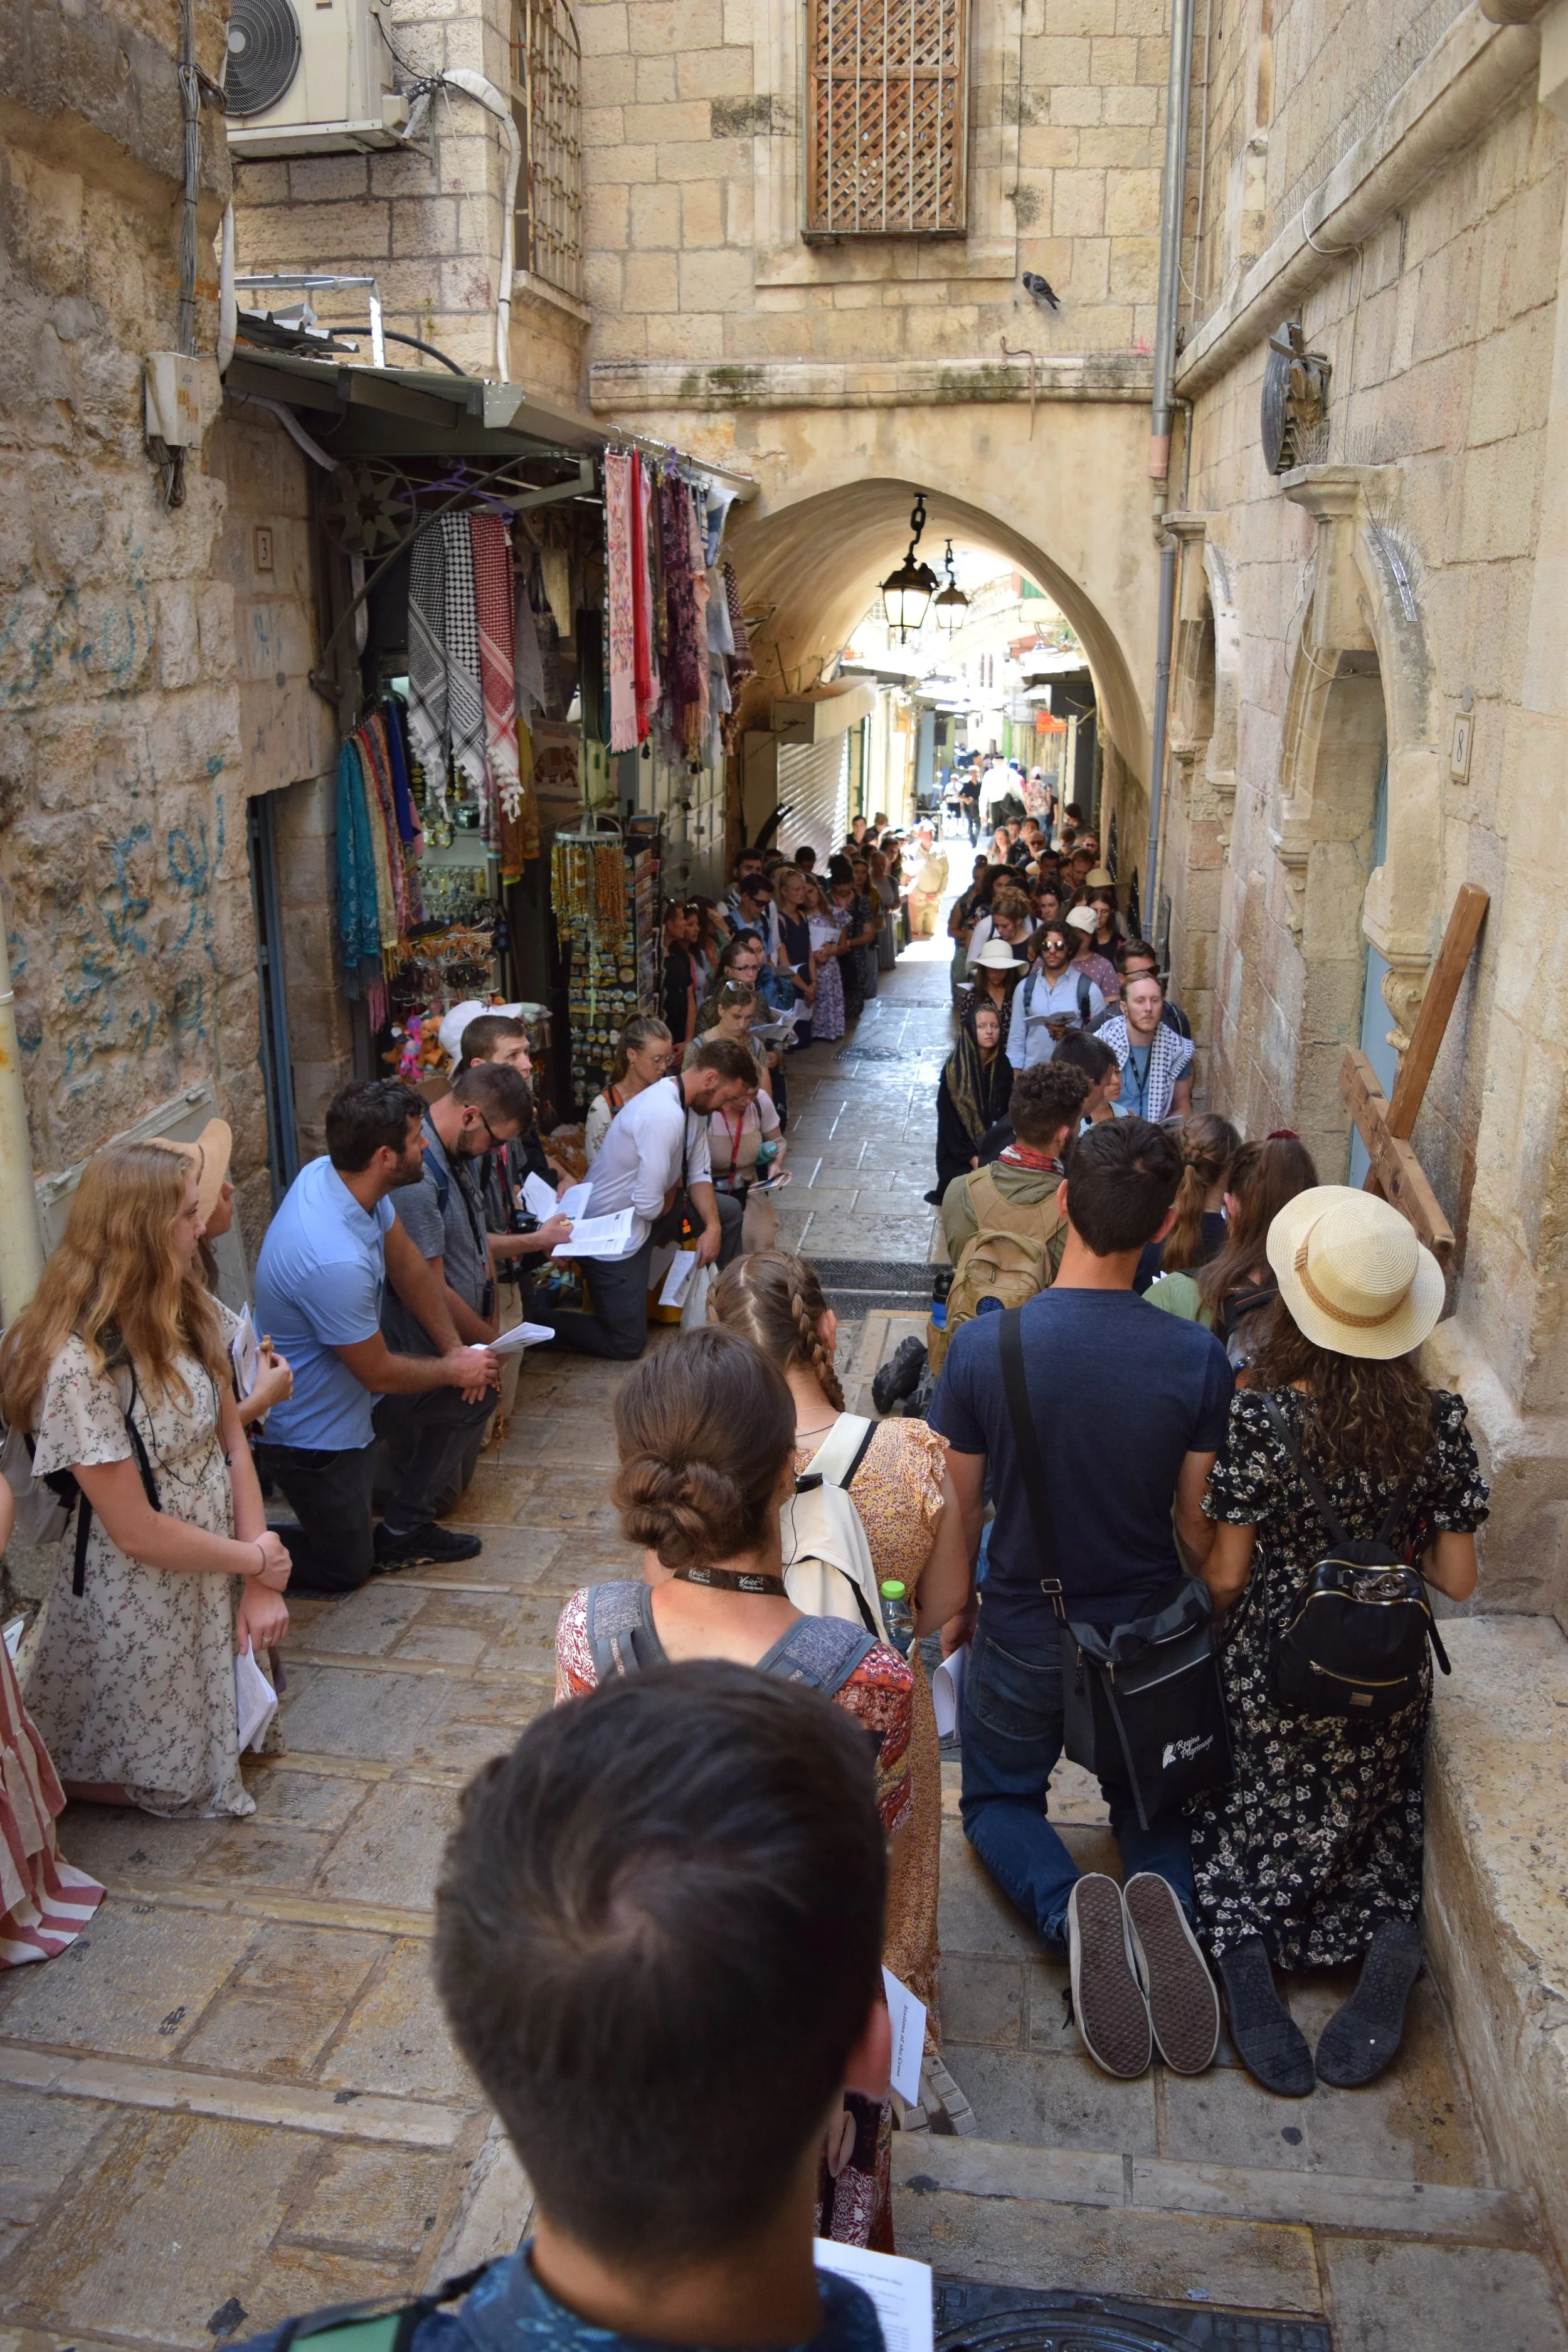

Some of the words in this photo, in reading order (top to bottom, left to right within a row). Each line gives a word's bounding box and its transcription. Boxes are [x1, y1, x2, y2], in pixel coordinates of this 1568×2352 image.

[262, 538, 267, 560] 3
[1456, 729, 1464, 762] 8
[738, 1576, 758, 1586] Voice
[1176, 1735, 1200, 1750] Regina
[1180, 1734, 1214, 1760] Pilgrimages
[901, 2005, 909, 2034] Stations
[899, 2034, 905, 2045] of
